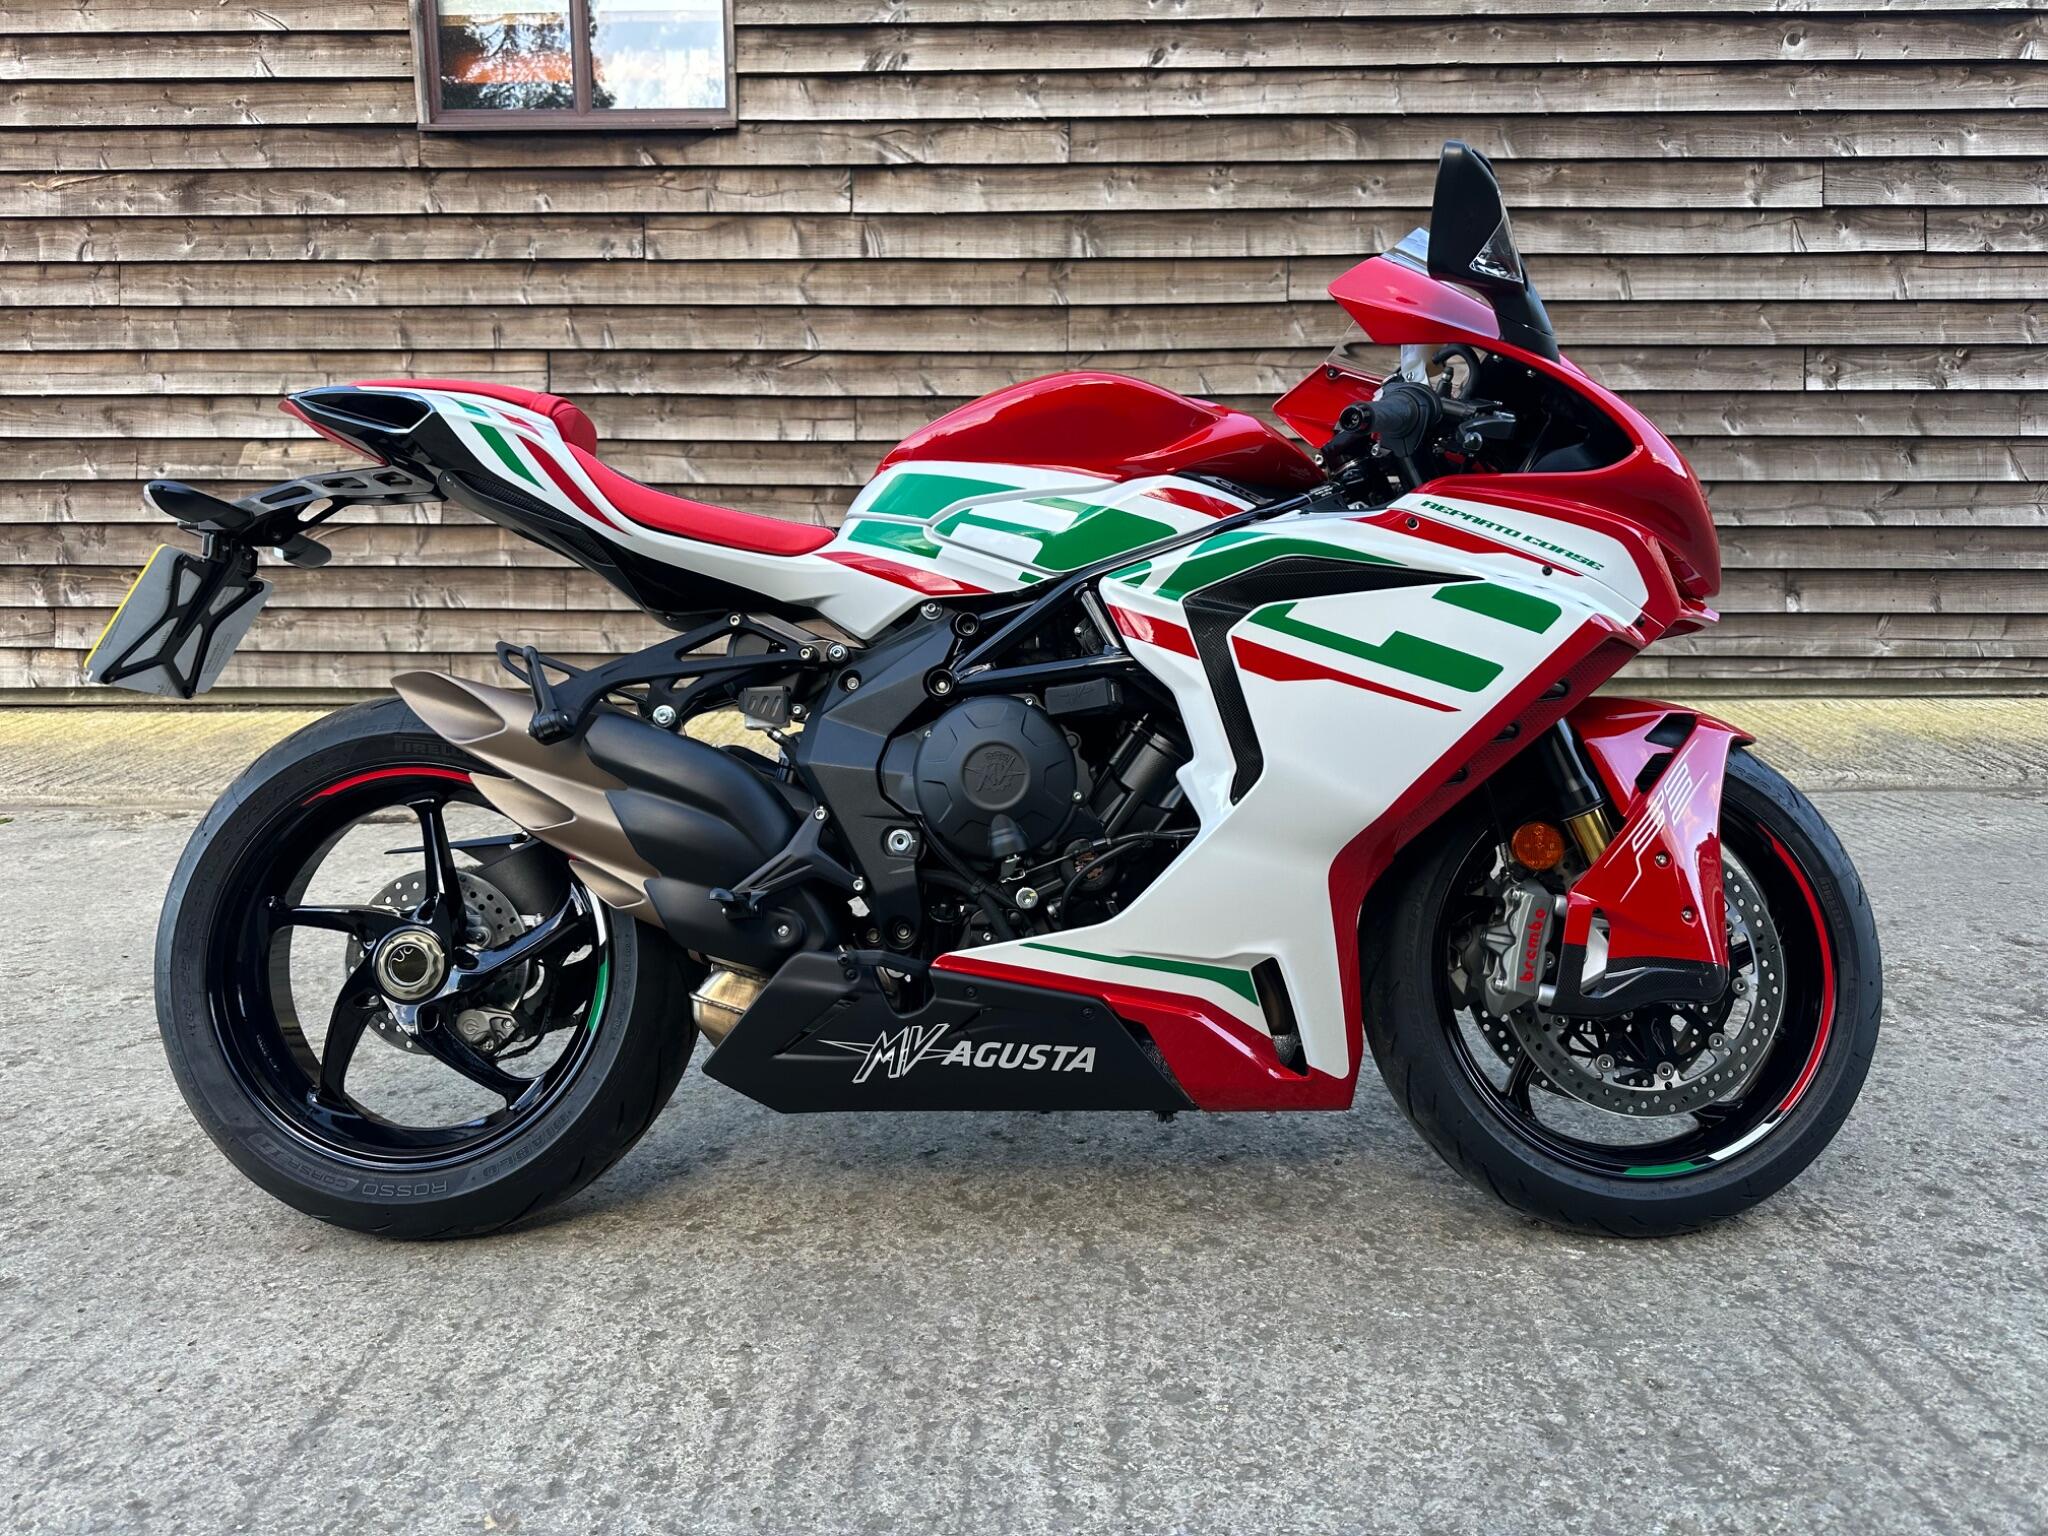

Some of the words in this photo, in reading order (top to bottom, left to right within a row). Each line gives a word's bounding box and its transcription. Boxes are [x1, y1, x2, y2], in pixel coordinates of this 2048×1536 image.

[1420, 500, 1521, 538] REPARTO
[1523, 535, 1605, 571] CORSE
[1519, 907, 1547, 983] brembo
[852, 1022, 951, 1084] MV
[940, 1040, 1097, 1073] AGUSTA
[361, 1178, 448, 1197] ROSSO
